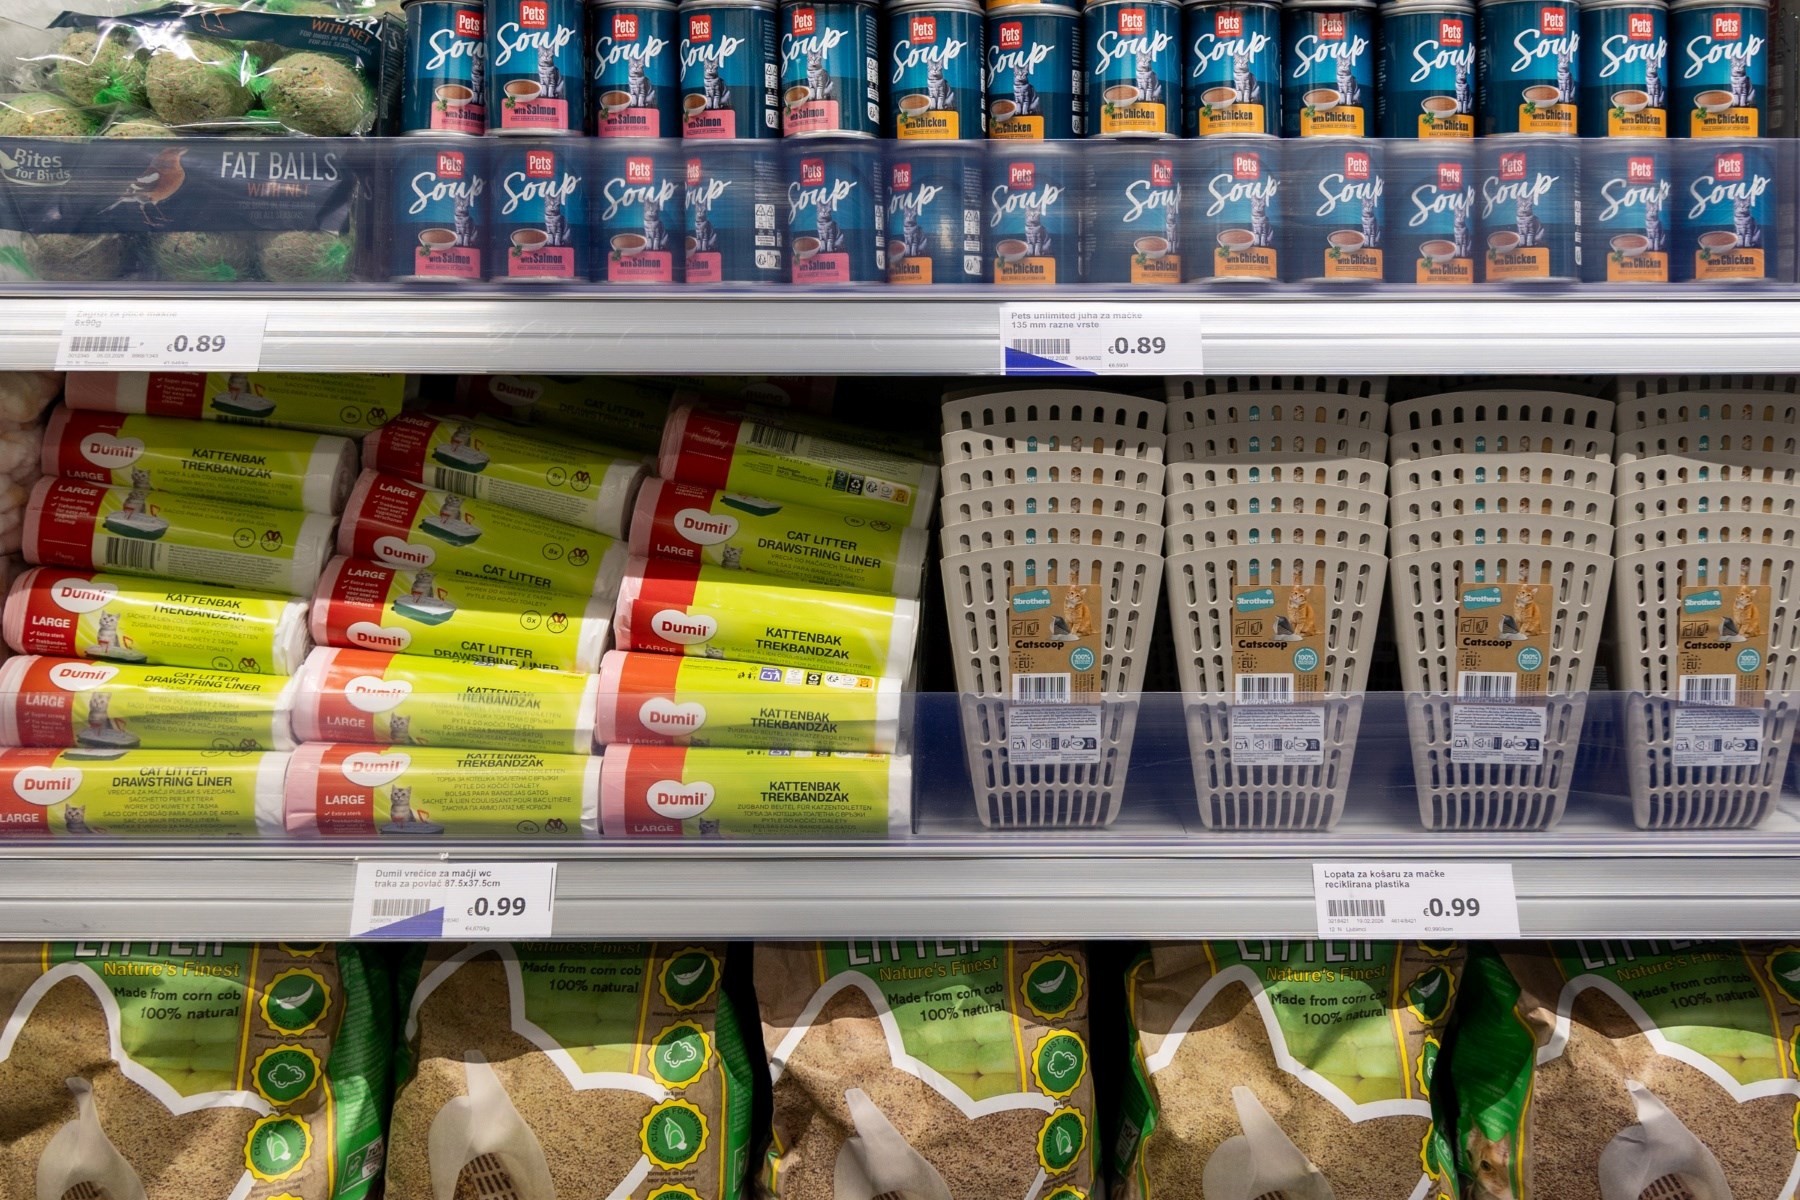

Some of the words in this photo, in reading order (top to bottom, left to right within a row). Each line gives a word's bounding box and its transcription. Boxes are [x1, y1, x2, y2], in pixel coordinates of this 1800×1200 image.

[523, 5, 545, 21] Pets
[1121, 13, 1142, 28] Pets
[1544, 12, 1564, 27] Pets
[459, 15, 480, 31] Pets
[615, 20, 635, 35] Pets
[691, 21, 709, 34] Pets
[794, 14, 812, 28] Pets
[1218, 15, 1240, 29] Pets
[1322, 18, 1342, 32] Pets
[1631, 18, 1651, 33] Pets
[1715, 17, 1738, 32] Pets
[312, 18, 345, 34] WITH
[348, 27, 372, 45] NET
[913, 22, 933, 36] Pets
[1002, 27, 1020, 42] Pets
[1443, 24, 1461, 39] Pets
[496, 22, 575, 66] Soup
[1511, 29, 1580, 72] Soup
[594, 35, 669, 80] Soup
[680, 35, 745, 82] Soup
[781, 27, 848, 77] Soup
[1095, 30, 1172, 75] Soup
[1193, 31, 1270, 77] Soup
[1293, 35, 1369, 78] Soup
[1599, 34, 1668, 78] Soup
[1684, 34, 1764, 78] Soup
[893, 37, 967, 84] Soup
[987, 42, 1055, 88] Soup
[1410, 40, 1476, 82] Soup
[527, 104, 556, 115] Salmon
[1124, 109, 1155, 119] Chicken
[1221, 109, 1253, 120] Chicken
[1325, 112, 1355, 122] Chicken
[696, 117, 721, 127] Salmon
[916, 117, 947, 128] Chicken
[1717, 113, 1749, 124] Chicken
[14, 148, 62, 168] Bites
[529, 156, 551, 170] Pets
[1718, 158, 1741, 173] Pets
[16, 167, 34, 179] for
[37, 168, 71, 180] Birds
[221, 152, 260, 178] FAT
[269, 152, 338, 180] BALLS
[409, 172, 486, 214] Soup
[502, 172, 581, 214] Soup
[602, 178, 678, 220] Soup
[1207, 174, 1280, 216] Soup
[1688, 175, 1770, 219] Soup
[1079, 312, 1098, 321] juha
[166, 335, 226, 352] €0.89
[1108, 337, 1166, 354] €0.89
[90, 442, 135, 459] Dumil
[192, 448, 267, 465] KATTENBAK
[181, 459, 273, 479] TREKBANDZAK
[683, 517, 728, 536] Dumil
[786, 530, 811, 544] CAT
[813, 535, 858, 551] LITTER
[656, 544, 694, 558] LARGE
[757, 538, 841, 563] DRAWSTRING
[844, 553, 882, 569] LINER
[347, 568, 387, 581] LARGE
[165, 592, 242, 609] KATTENBAK
[32, 615, 71, 628] LARGE
[661, 620, 707, 637] Dumil
[357, 632, 402, 647] Dumil
[765, 626, 842, 646] KATTENBAK
[1463, 637, 1512, 649] Catscoop
[461, 641, 487, 651] CAT
[490, 644, 533, 659] LITTER
[755, 639, 849, 660] TREKBANDZAK
[1015, 640, 1064, 650] Catscoop
[1239, 640, 1287, 650] Catscoop
[1684, 641, 1732, 651] Catscoop
[1019, 660, 1029, 668] EU
[650, 711, 696, 726] Dumil
[456, 759, 544, 768] TREKBANDZAK
[139, 767, 162, 777] CAT
[165, 766, 207, 777] LITTER
[24, 778, 72, 791] Dumil
[112, 777, 194, 787] DRAWSTRING
[195, 777, 233, 787] LINER
[769, 781, 840, 792] KATTENBAK
[325, 794, 366, 806] LARGE
[657, 792, 705, 806] Dumil
[760, 792, 849, 803] TREKBANDZAK
[0, 813, 39, 823] LARGE
[634, 824, 675, 832] LARGE
[376, 870, 402, 878] Dumil
[452, 869, 476, 879] mačji
[1324, 870, 1355, 879] Lopata
[1370, 870, 1400, 878] košaru
[1416, 870, 1445, 878] mačke
[375, 880, 397, 888] traka
[1375, 881, 1410, 889] plastika
[467, 897, 526, 917] €0.99
[1423, 898, 1480, 917] €0.99
[103, 961, 177, 977] Nature's
[182, 961, 241, 977] Finest
[879, 963, 947, 982] Nature's
[951, 956, 999, 976] Finest
[113, 987, 147, 999] Made
[150, 989, 178, 1000] from
[182, 990, 212, 1001] corn
[217, 989, 241, 1000] cob
[888, 992, 921, 1005] Made
[925, 989, 953, 1003] from
[957, 989, 981, 1000] corn
[984, 982, 1003, 995] cob
[141, 1006, 182, 1020] 100%
[187, 1006, 239, 1019] natural
[920, 1006, 959, 1022] 100%
[963, 999, 1006, 1018] natural
[1303, 1012, 1342, 1025] 100%
[1345, 1008, 1387, 1021] natural
[1044, 1038, 1060, 1058] DUST
[1062, 1037, 1080, 1050] FREE
